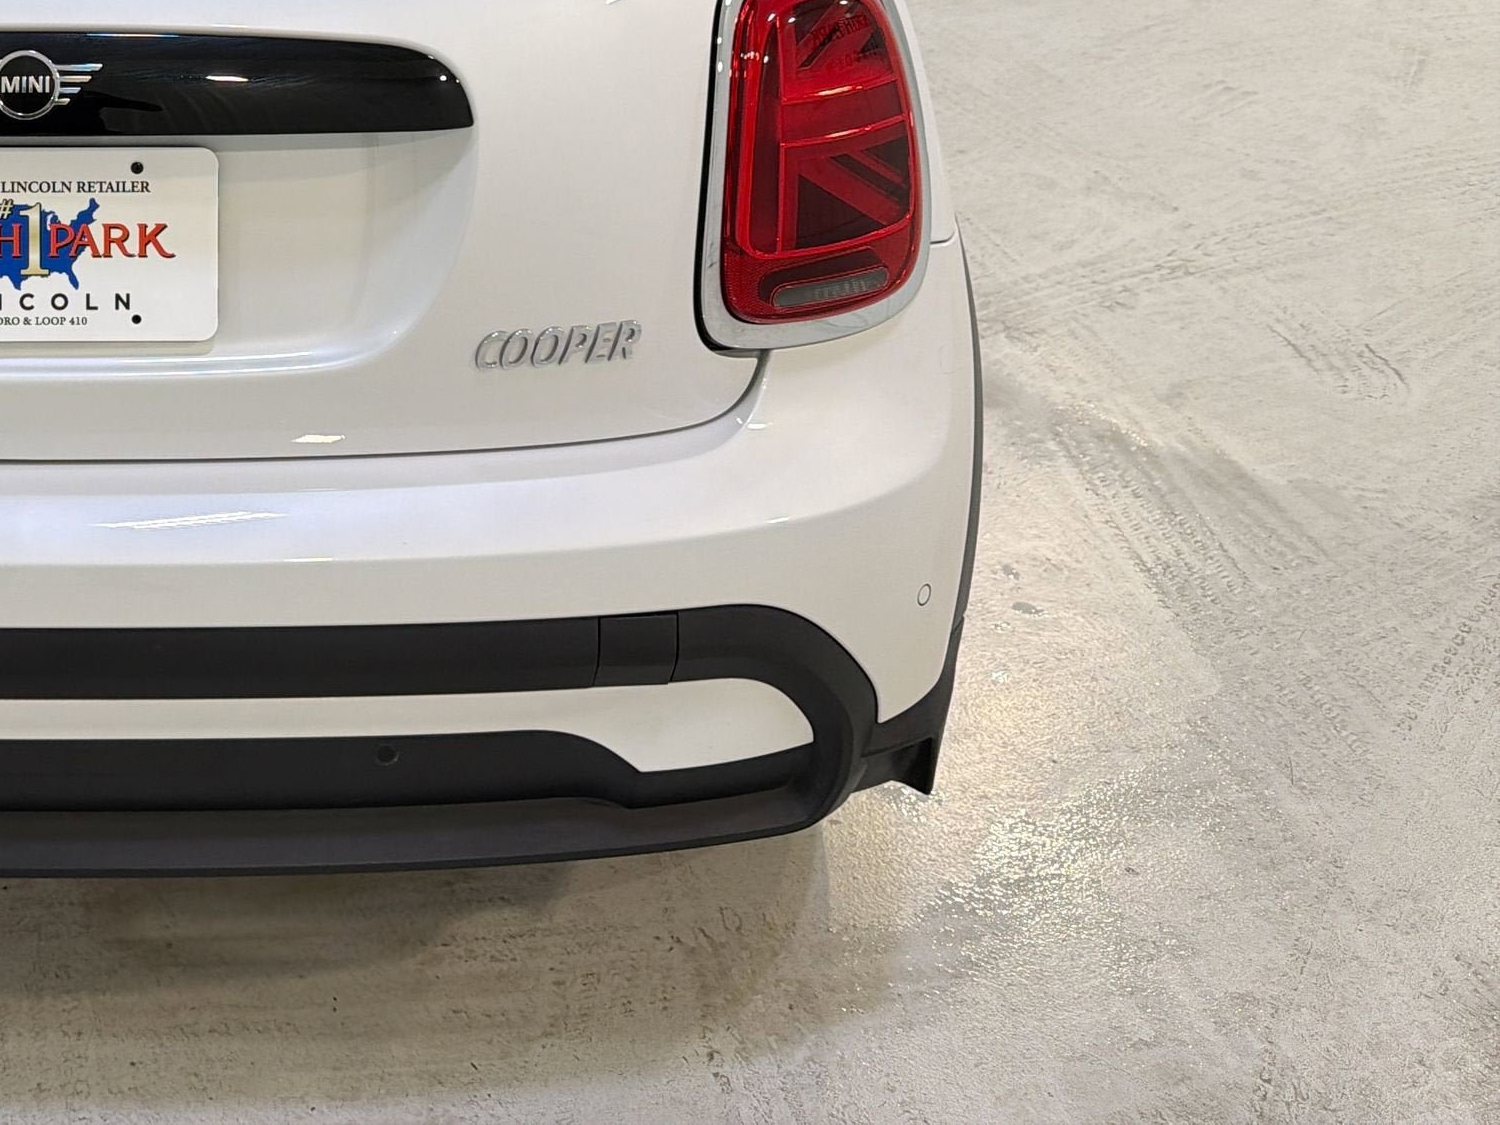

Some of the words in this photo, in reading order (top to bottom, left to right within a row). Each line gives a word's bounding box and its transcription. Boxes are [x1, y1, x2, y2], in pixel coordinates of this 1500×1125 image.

[0, 75, 51, 94] MINI
[0, 180, 73, 194] LINCOLN
[76, 180, 152, 194] RETAILER
[47, 222, 177, 260] PARK
[22, 316, 33, 326] &
[34, 316, 67, 326] LOOP
[68, 316, 88, 326] 410
[474, 320, 642, 371] COOPER
